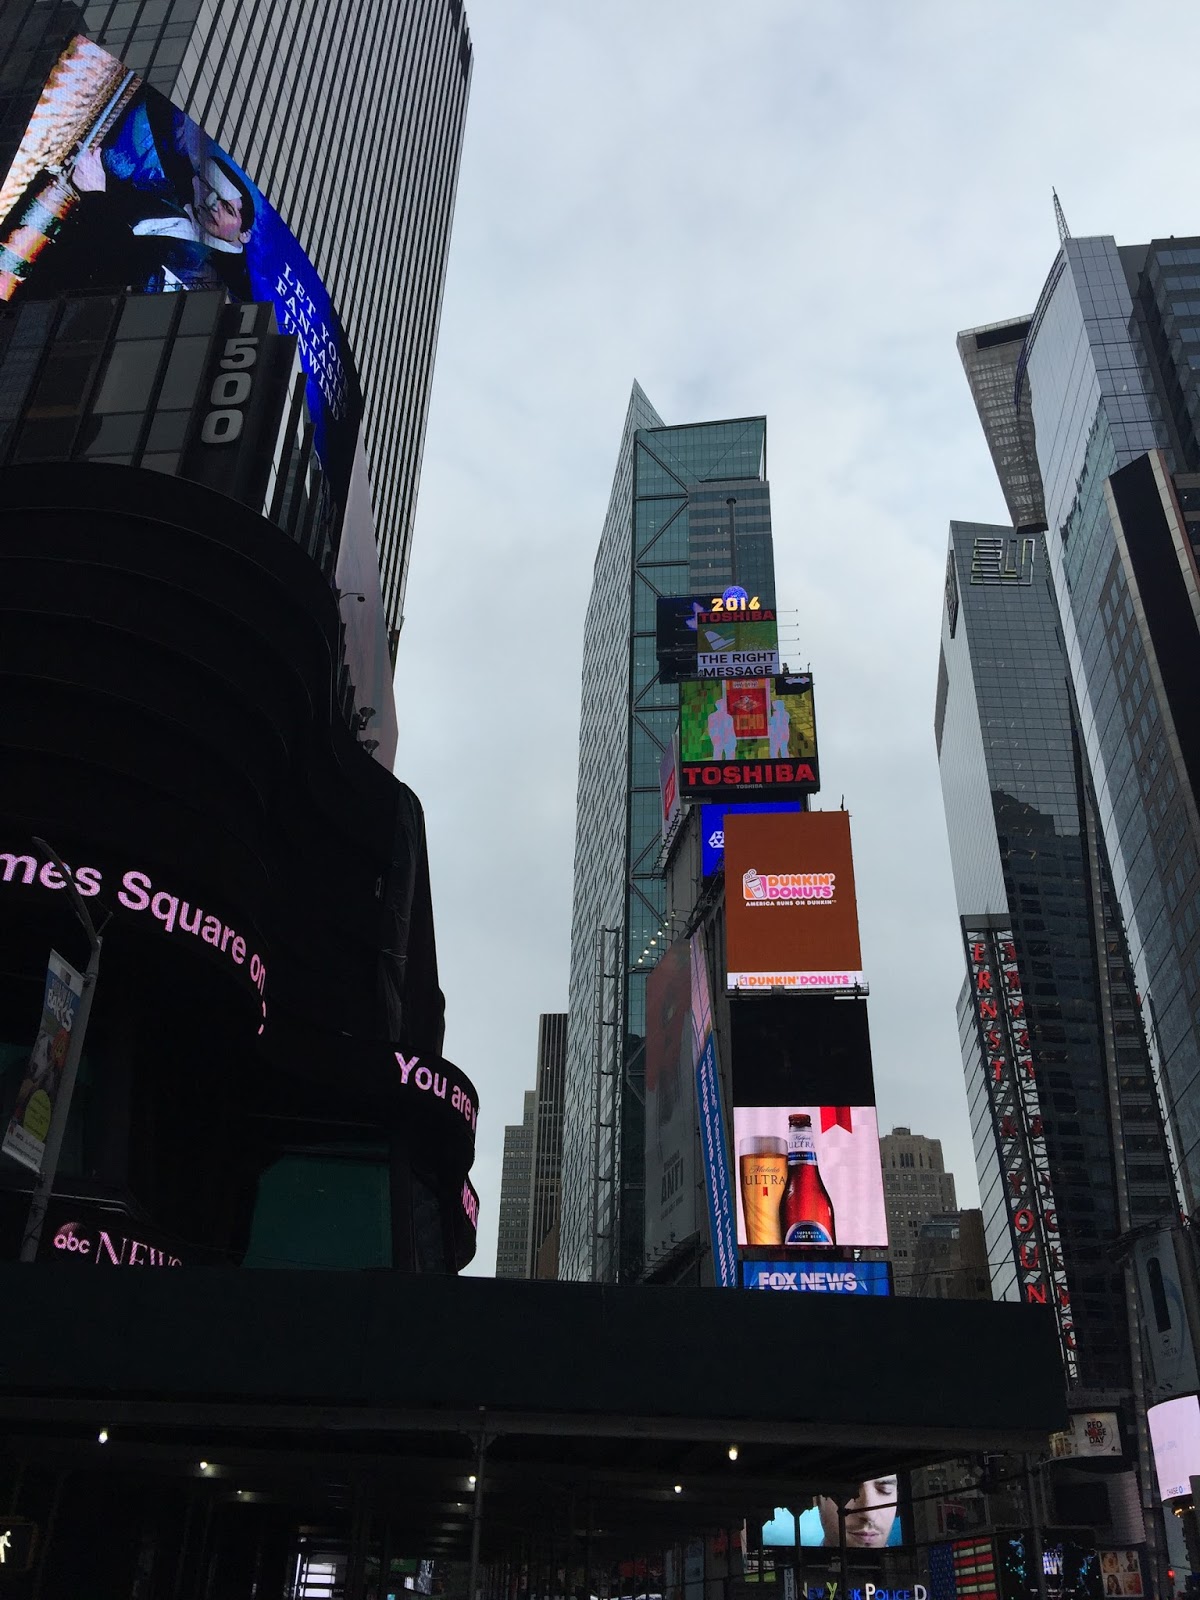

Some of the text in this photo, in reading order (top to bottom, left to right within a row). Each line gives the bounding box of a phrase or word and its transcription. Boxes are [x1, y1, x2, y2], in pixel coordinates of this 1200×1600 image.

[283, 262, 316, 318] LET
[284, 309, 340, 421] UNWIND
[201, 303, 260, 444] 1500
[711, 596, 761, 612] 2016
[699, 610, 775, 623] TOSHIBA
[700, 652, 776, 664] THE RIGHT
[703, 665, 773, 677] MESSAGE
[682, 763, 816, 786] TOSHIBA
[768, 886, 833, 899] DONUTS
[117, 869, 247, 965] Square
[748, 975, 849, 986] DUNKIN' DONUTS
[394, 1051, 449, 1100] You
[450, 1084, 472, 1122] are
[745, 1175, 786, 1185] ULTRA
[53, 1231, 91, 1254] abc
[758, 1272, 858, 1291] FOX NEWS
[1086, 1421, 1102, 1429] RED
[1089, 1436, 1105, 1445] DAY
